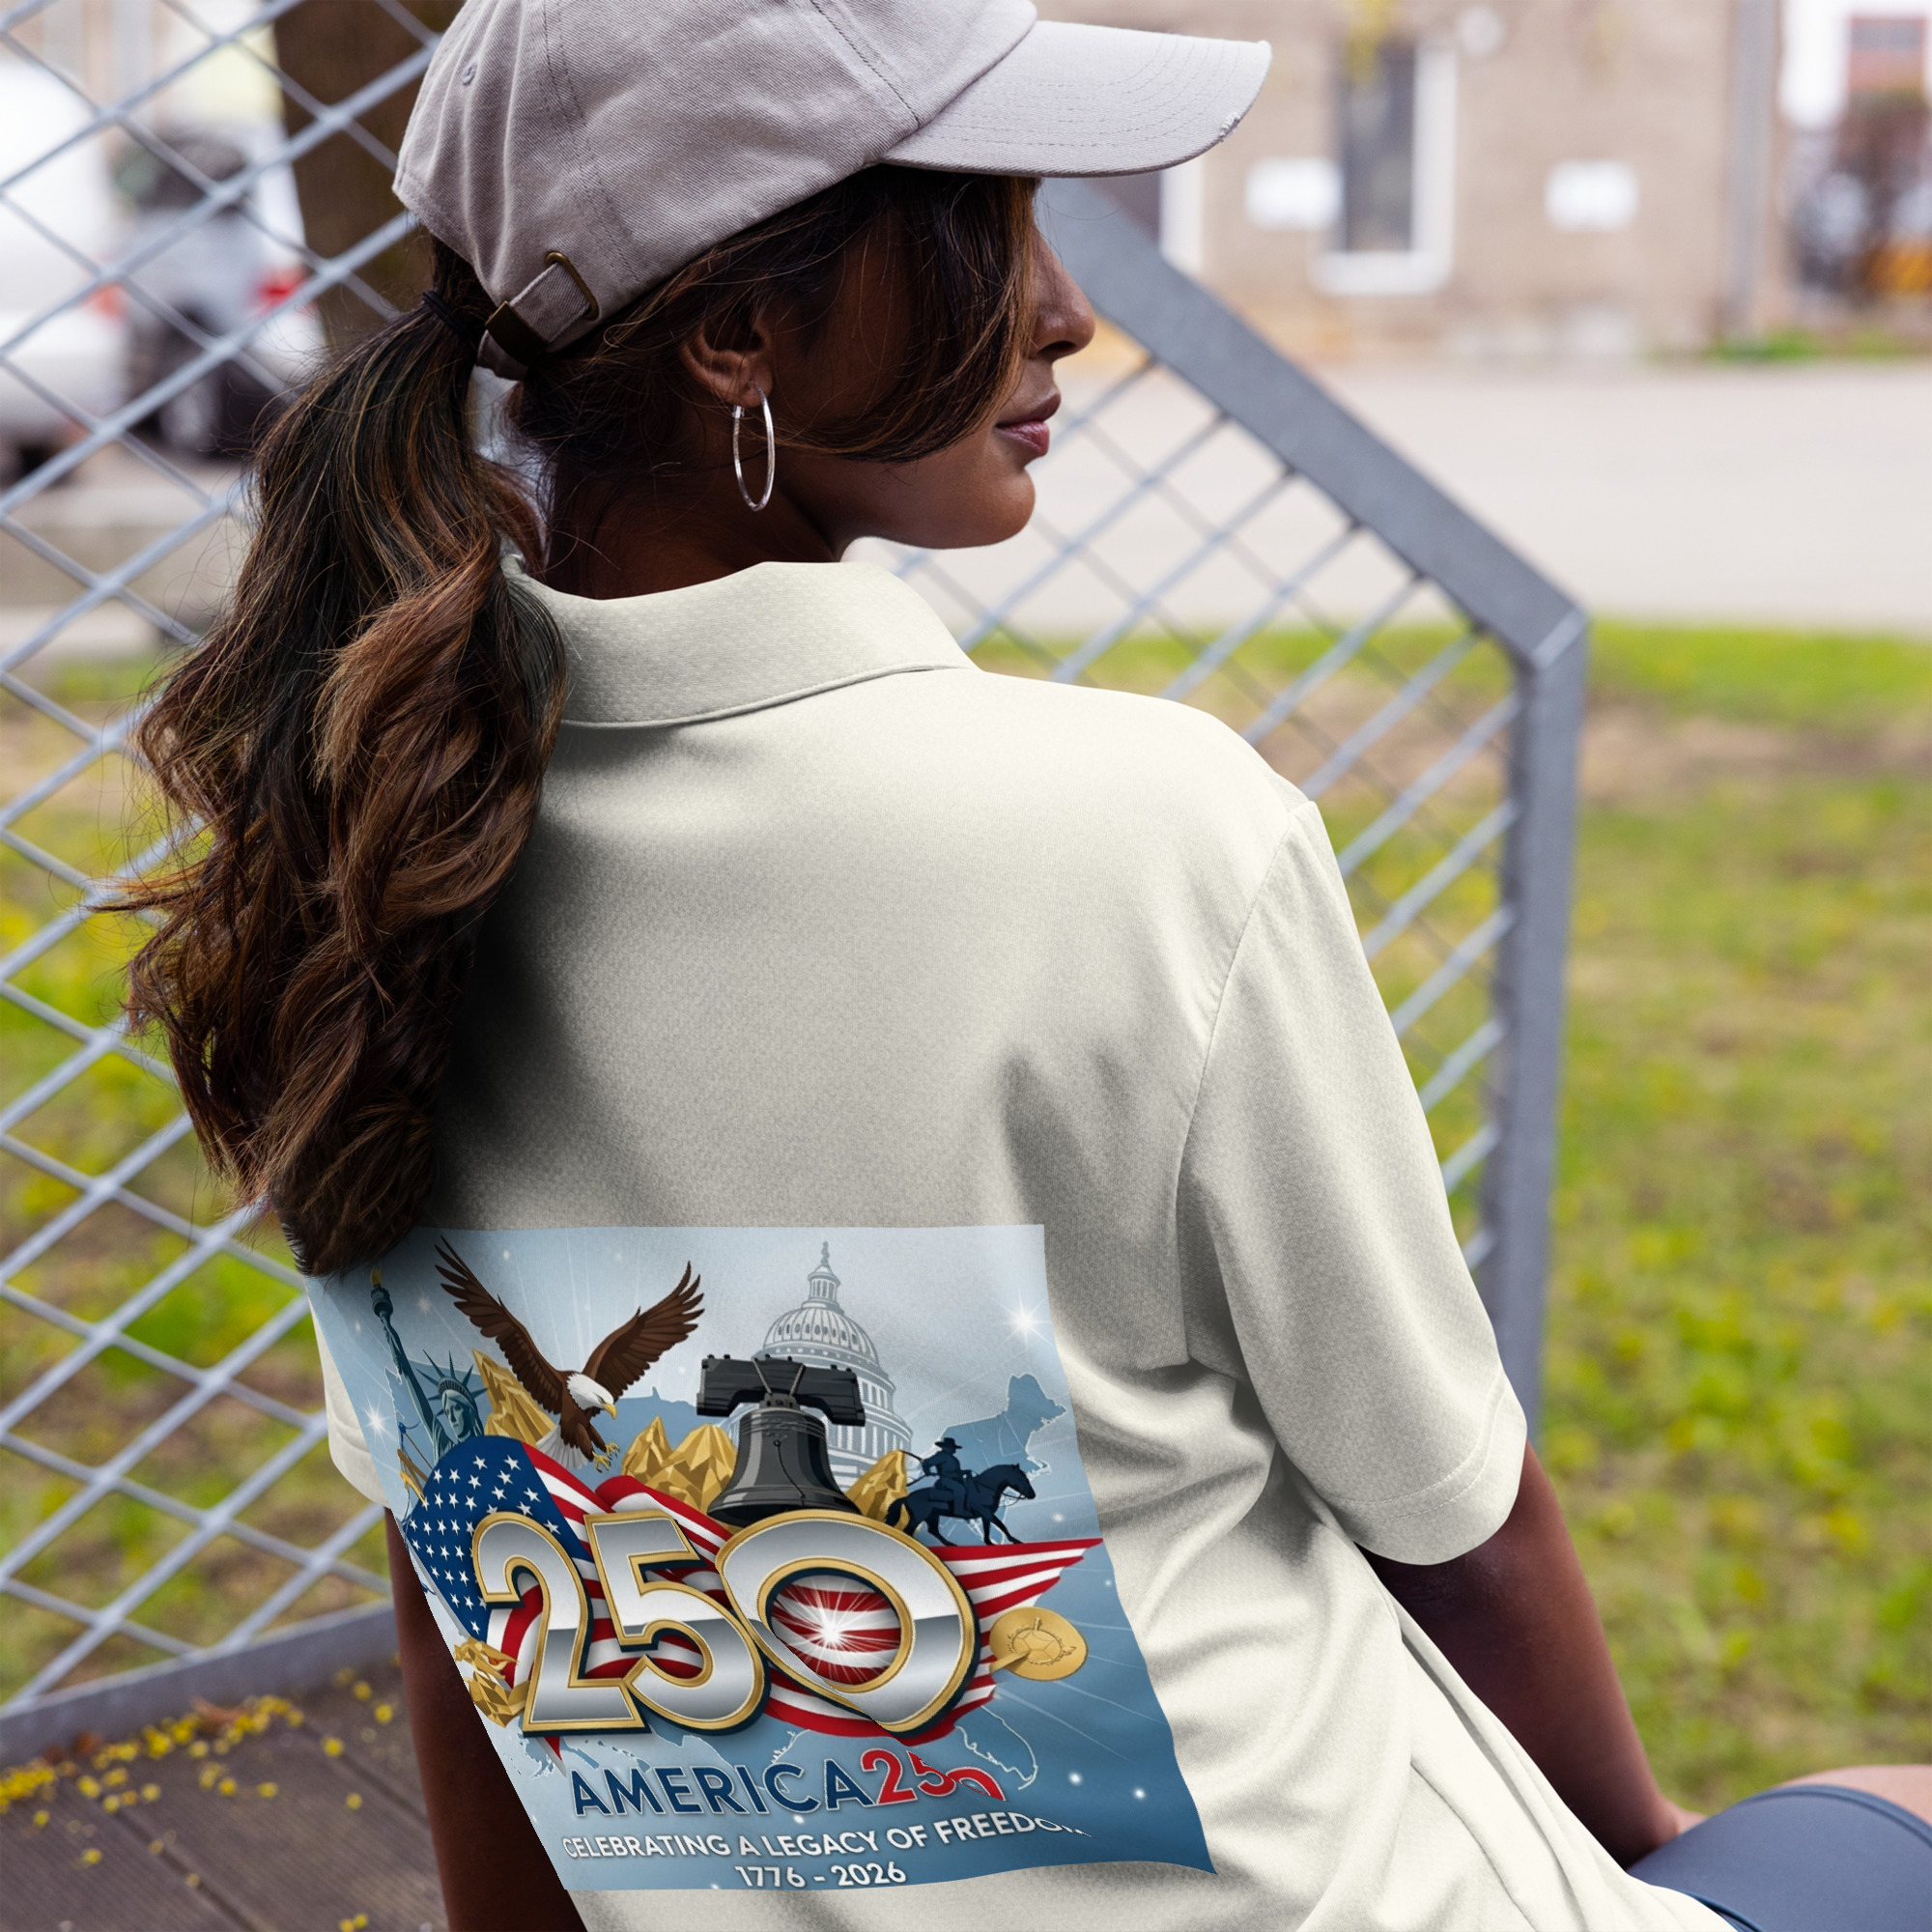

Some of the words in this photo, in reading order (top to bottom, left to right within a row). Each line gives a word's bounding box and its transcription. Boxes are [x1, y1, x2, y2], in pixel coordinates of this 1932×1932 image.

[471, 1508, 978, 1736] 250
[562, 1834, 731, 1858] CELEBRATING
[739, 1835, 761, 1857] A
[760, 1831, 879, 1857] LEGACY
[886, 1824, 927, 1849] OF
[932, 1811, 1094, 1844] FREEDO
[734, 1865, 806, 1888] 1776
[830, 1861, 906, 1887] 2026
